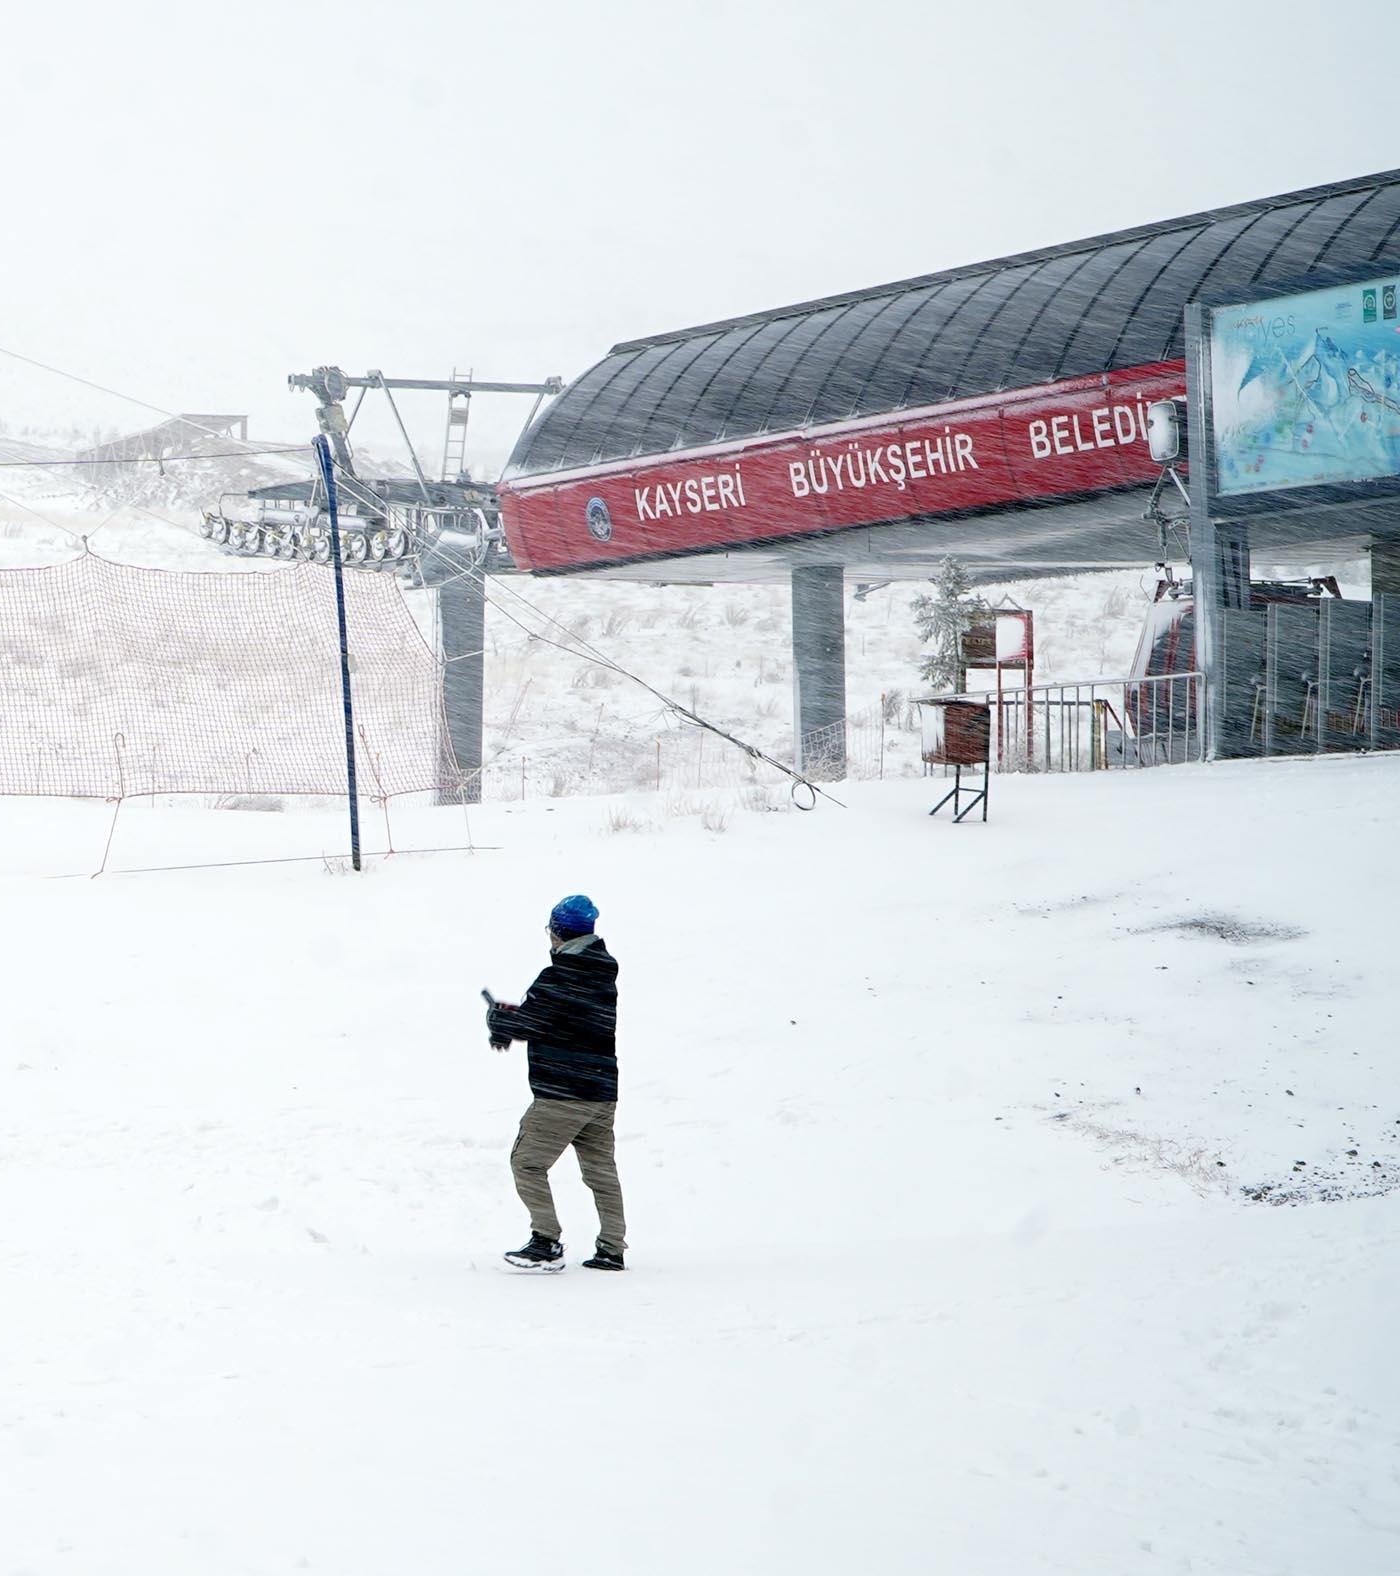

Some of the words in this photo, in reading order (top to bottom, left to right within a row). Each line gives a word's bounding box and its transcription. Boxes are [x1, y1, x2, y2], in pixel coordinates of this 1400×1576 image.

[634, 463, 746, 521] KAYSERİ
[789, 426, 979, 498] BÜYÜKŞEHİR
[1028, 391, 1187, 460] BELEDİ
